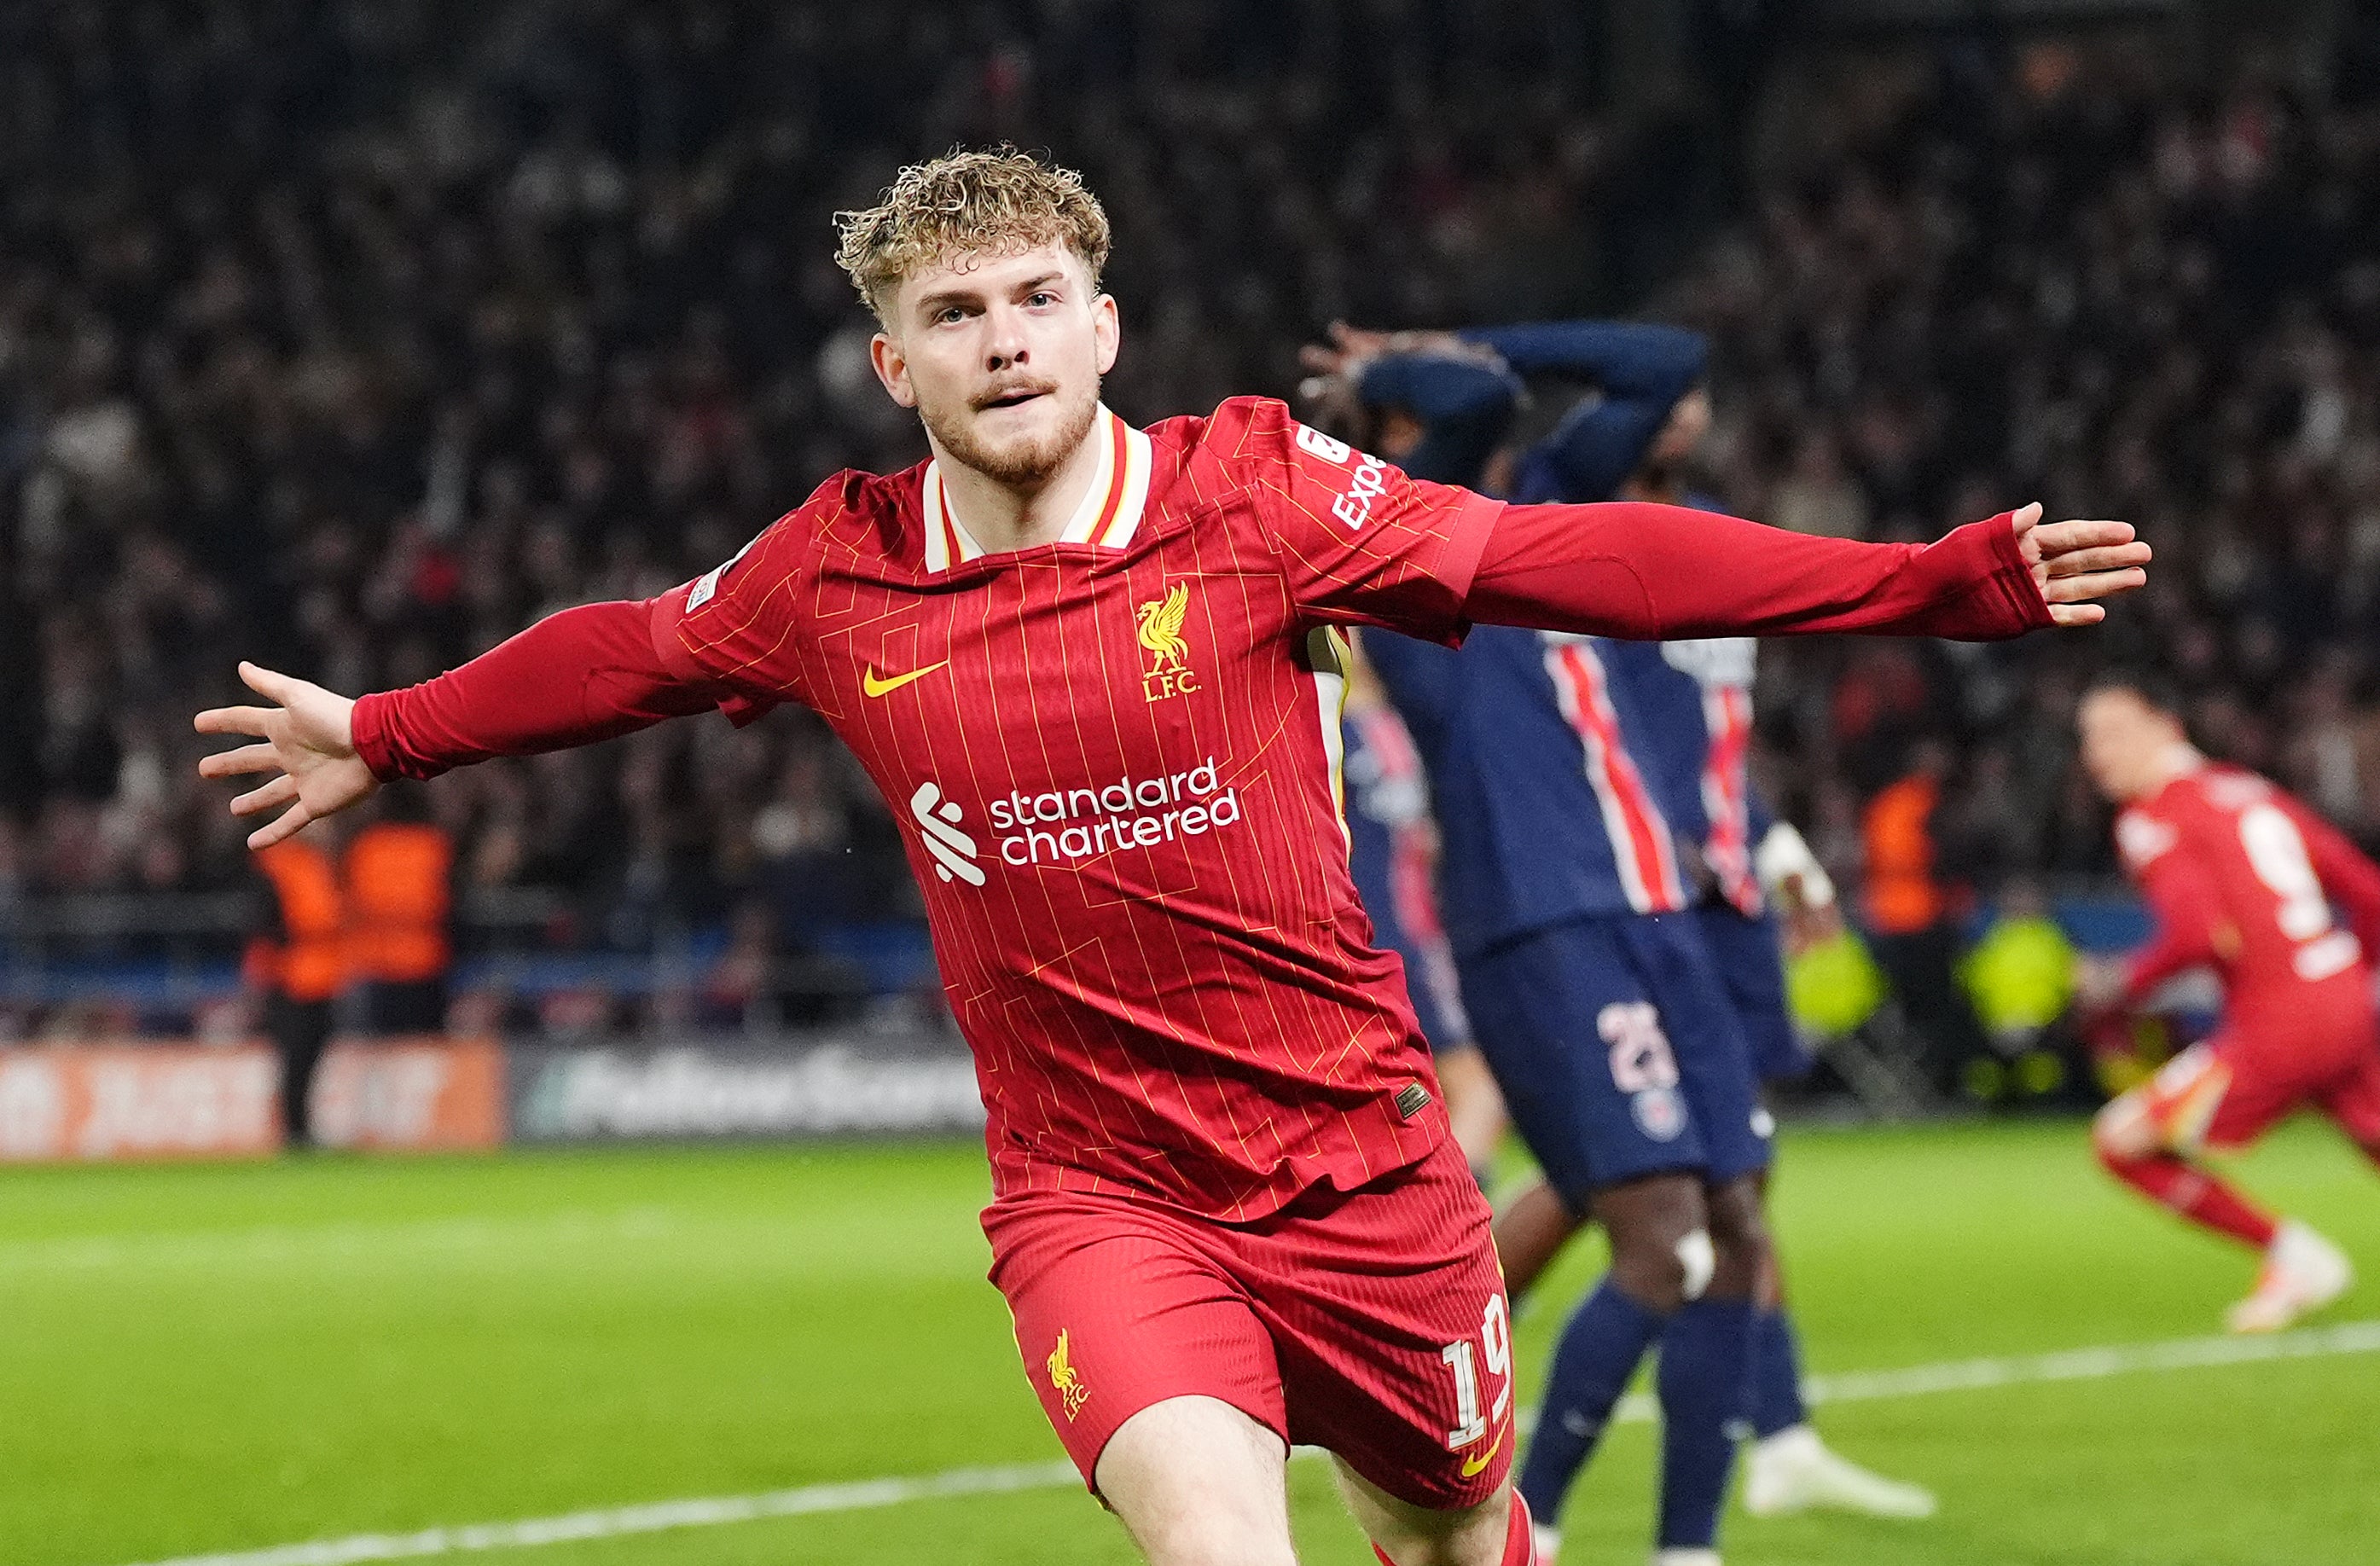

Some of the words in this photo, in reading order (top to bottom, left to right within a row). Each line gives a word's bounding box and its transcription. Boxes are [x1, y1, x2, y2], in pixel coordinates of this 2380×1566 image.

[1141, 670, 1202, 703] L.F.C.
[990, 755, 1218, 829] standard
[1001, 786, 1240, 866] chartered
[1443, 1293, 1511, 1449] 19
